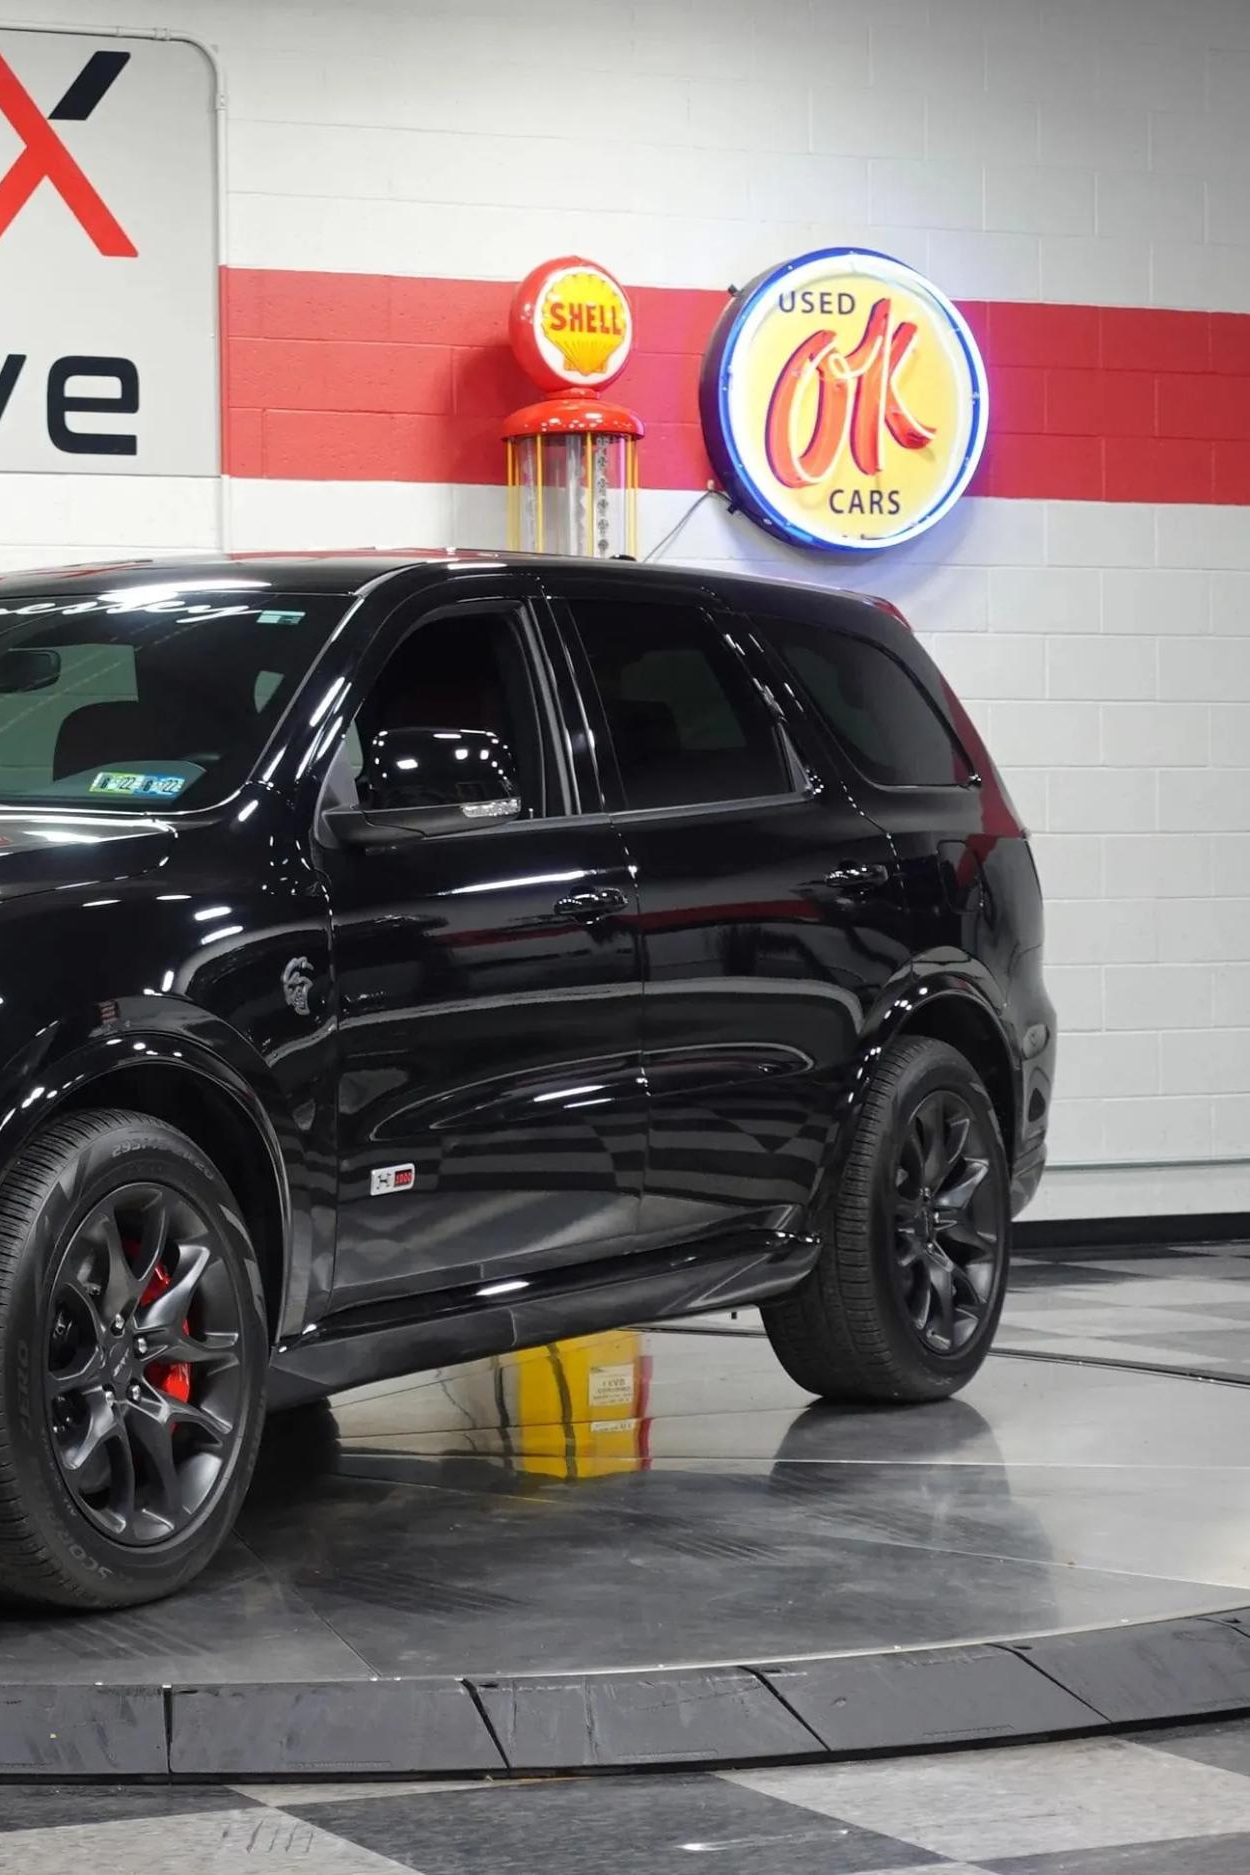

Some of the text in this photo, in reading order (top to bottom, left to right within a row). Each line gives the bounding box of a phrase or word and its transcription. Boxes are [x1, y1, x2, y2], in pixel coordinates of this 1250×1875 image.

[778, 291, 856, 315] USED
[550, 302, 622, 336] SHELL
[765, 297, 937, 488] OK
[829, 489, 901, 515] CARS
